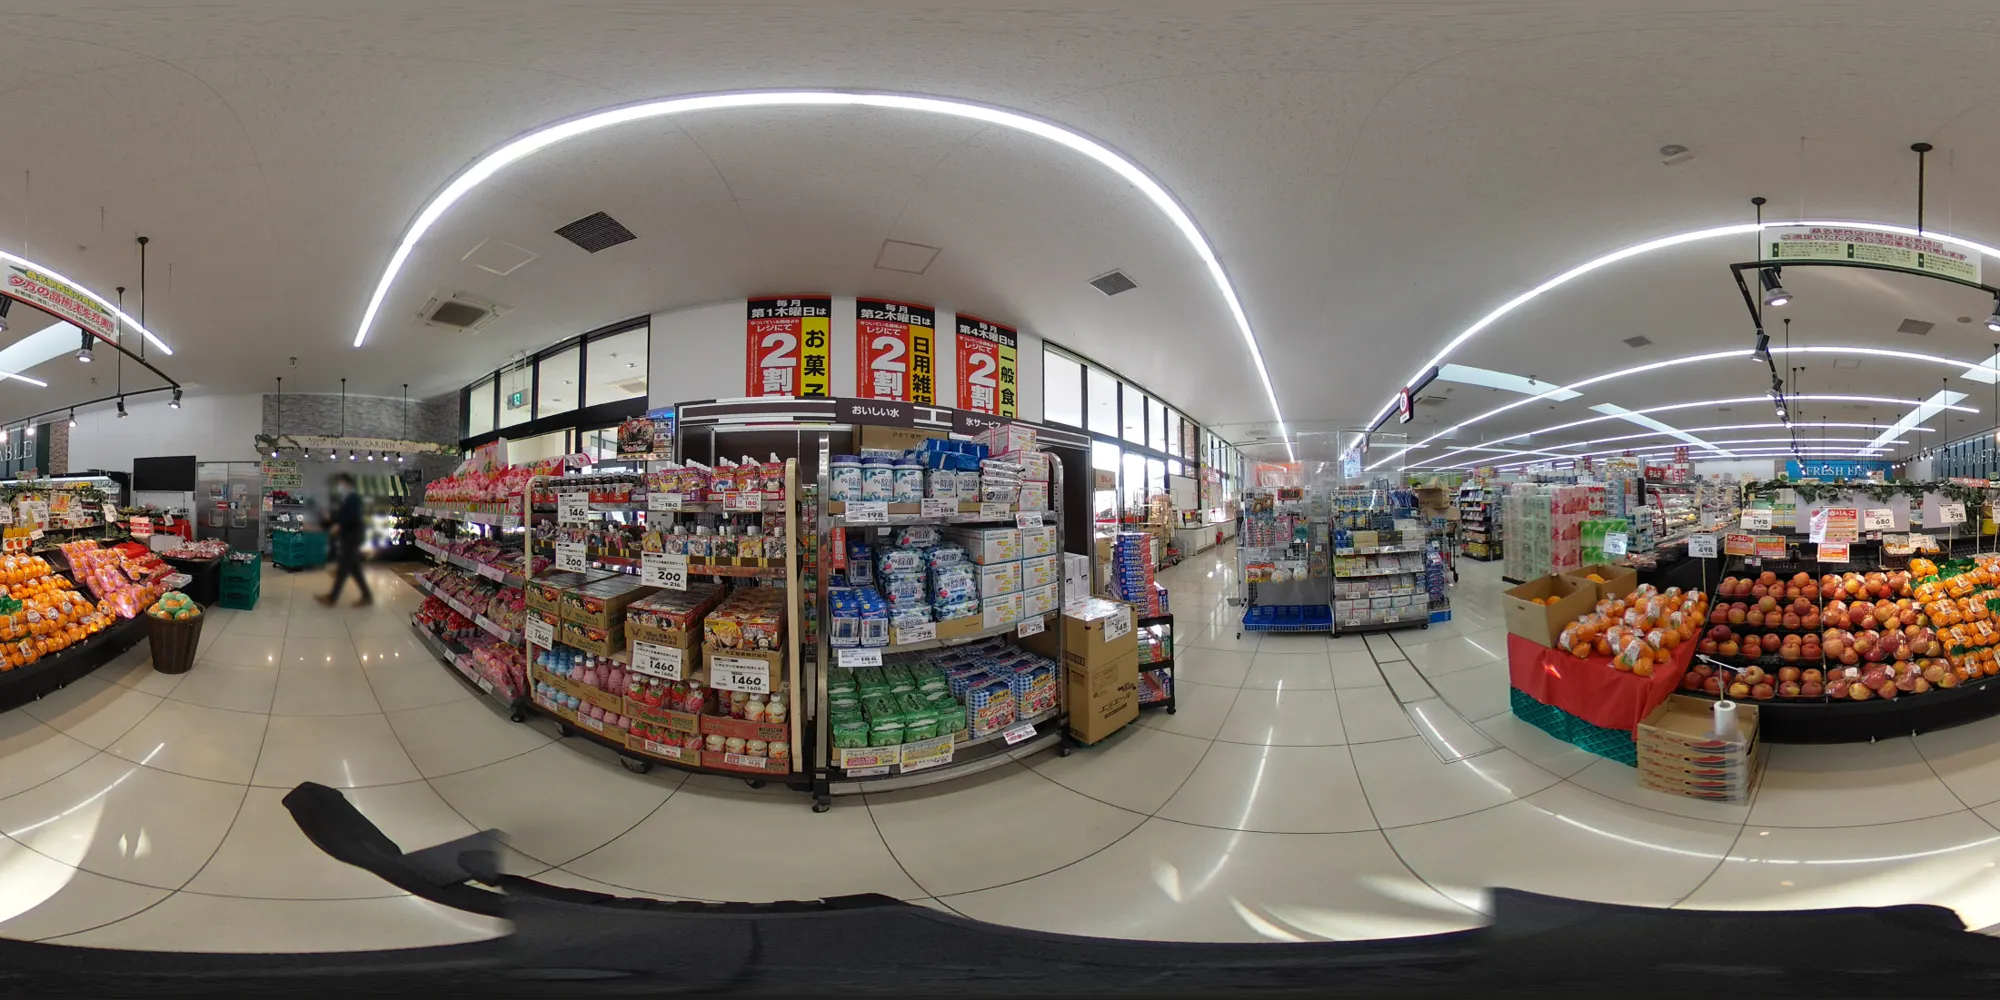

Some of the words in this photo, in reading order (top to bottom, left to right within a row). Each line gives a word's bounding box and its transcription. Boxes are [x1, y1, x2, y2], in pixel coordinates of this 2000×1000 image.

[751, 307, 827, 318] 第1木曜日は
[860, 308, 931, 326] 第2木曜日は
[757, 324, 792, 332] レジにて
[866, 326, 901, 336] レジにて
[959, 324, 1015, 347] 第4木曜日は
[964, 341, 992, 354] レジにて
[1401, 396, 1406, 408] 6
[851, 405, 900, 418] おいしい水
[330, 439, 362, 448] FLOWER
[364, 440, 396, 449] GARDEN
[1805, 466, 1844, 476] FRESH
[569, 508, 585, 517] 146
[565, 558, 582, 567] 200
[657, 571, 681, 582] 200
[1114, 621, 1128, 633] 348
[725, 650, 768, 659] 大正製薬株式会社
[1099, 692, 1132, 713] エリエール
